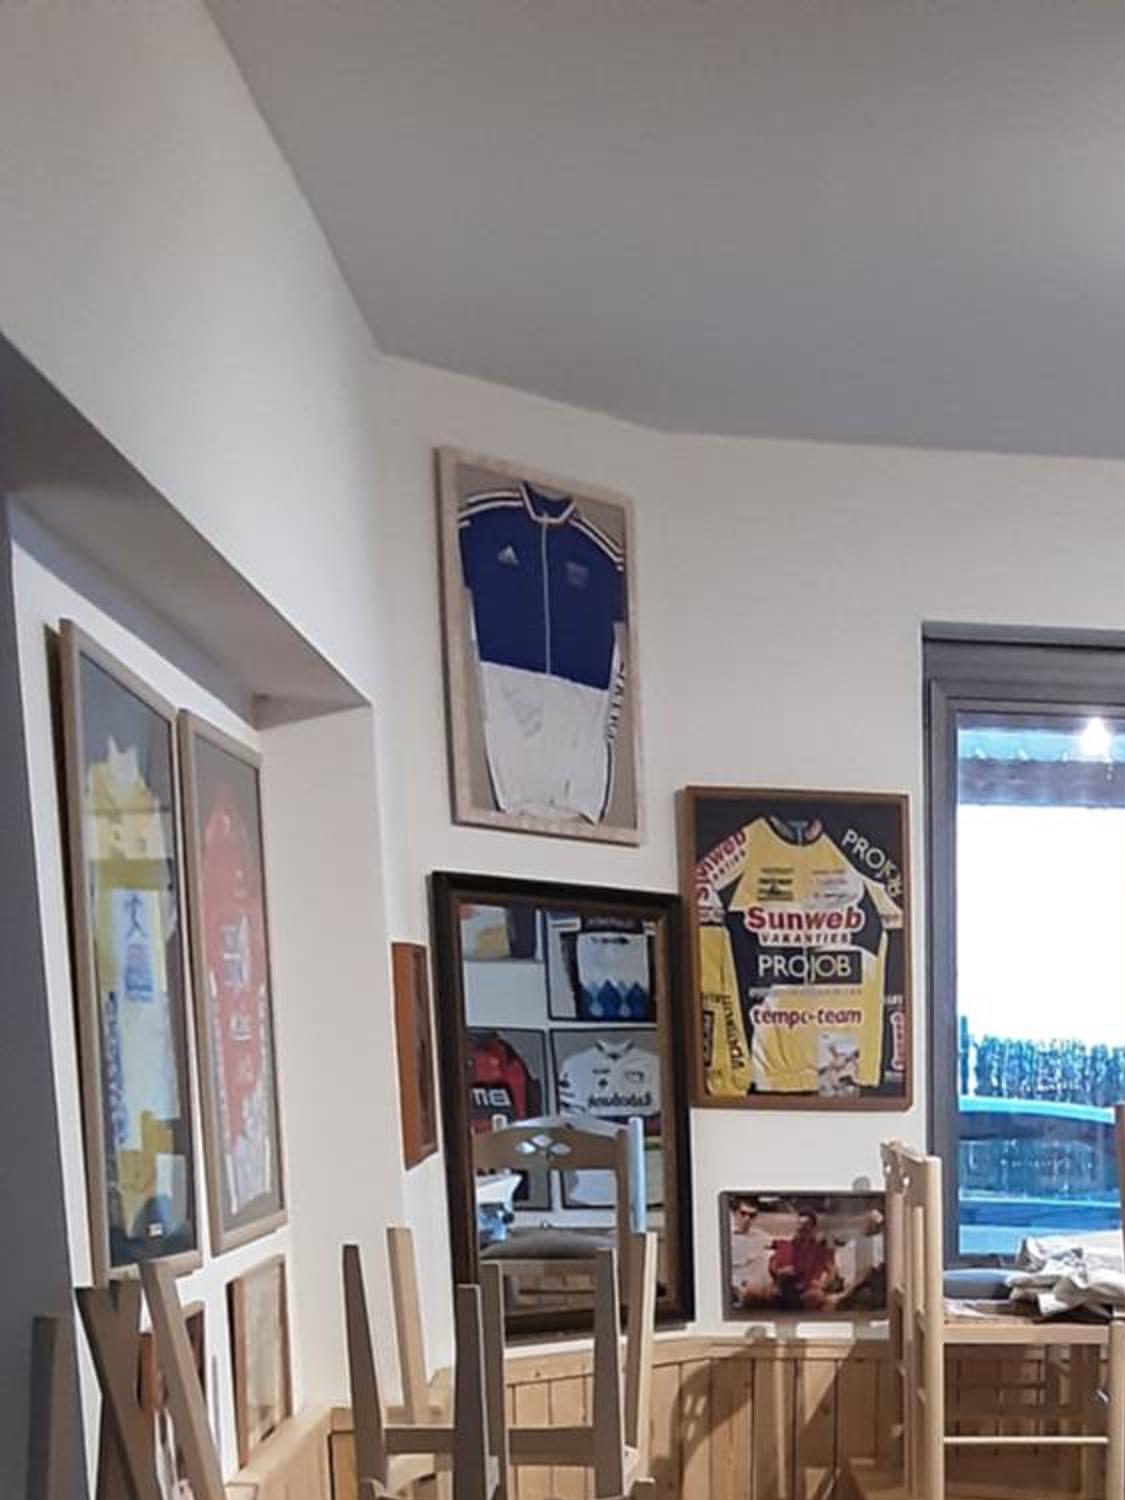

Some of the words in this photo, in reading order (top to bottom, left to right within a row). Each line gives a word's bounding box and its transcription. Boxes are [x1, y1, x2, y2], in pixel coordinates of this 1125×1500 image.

[747, 906, 863, 930] Sunweb
[761, 933, 850, 945] VAKANTIES
[758, 954, 852, 982] PROJOB
